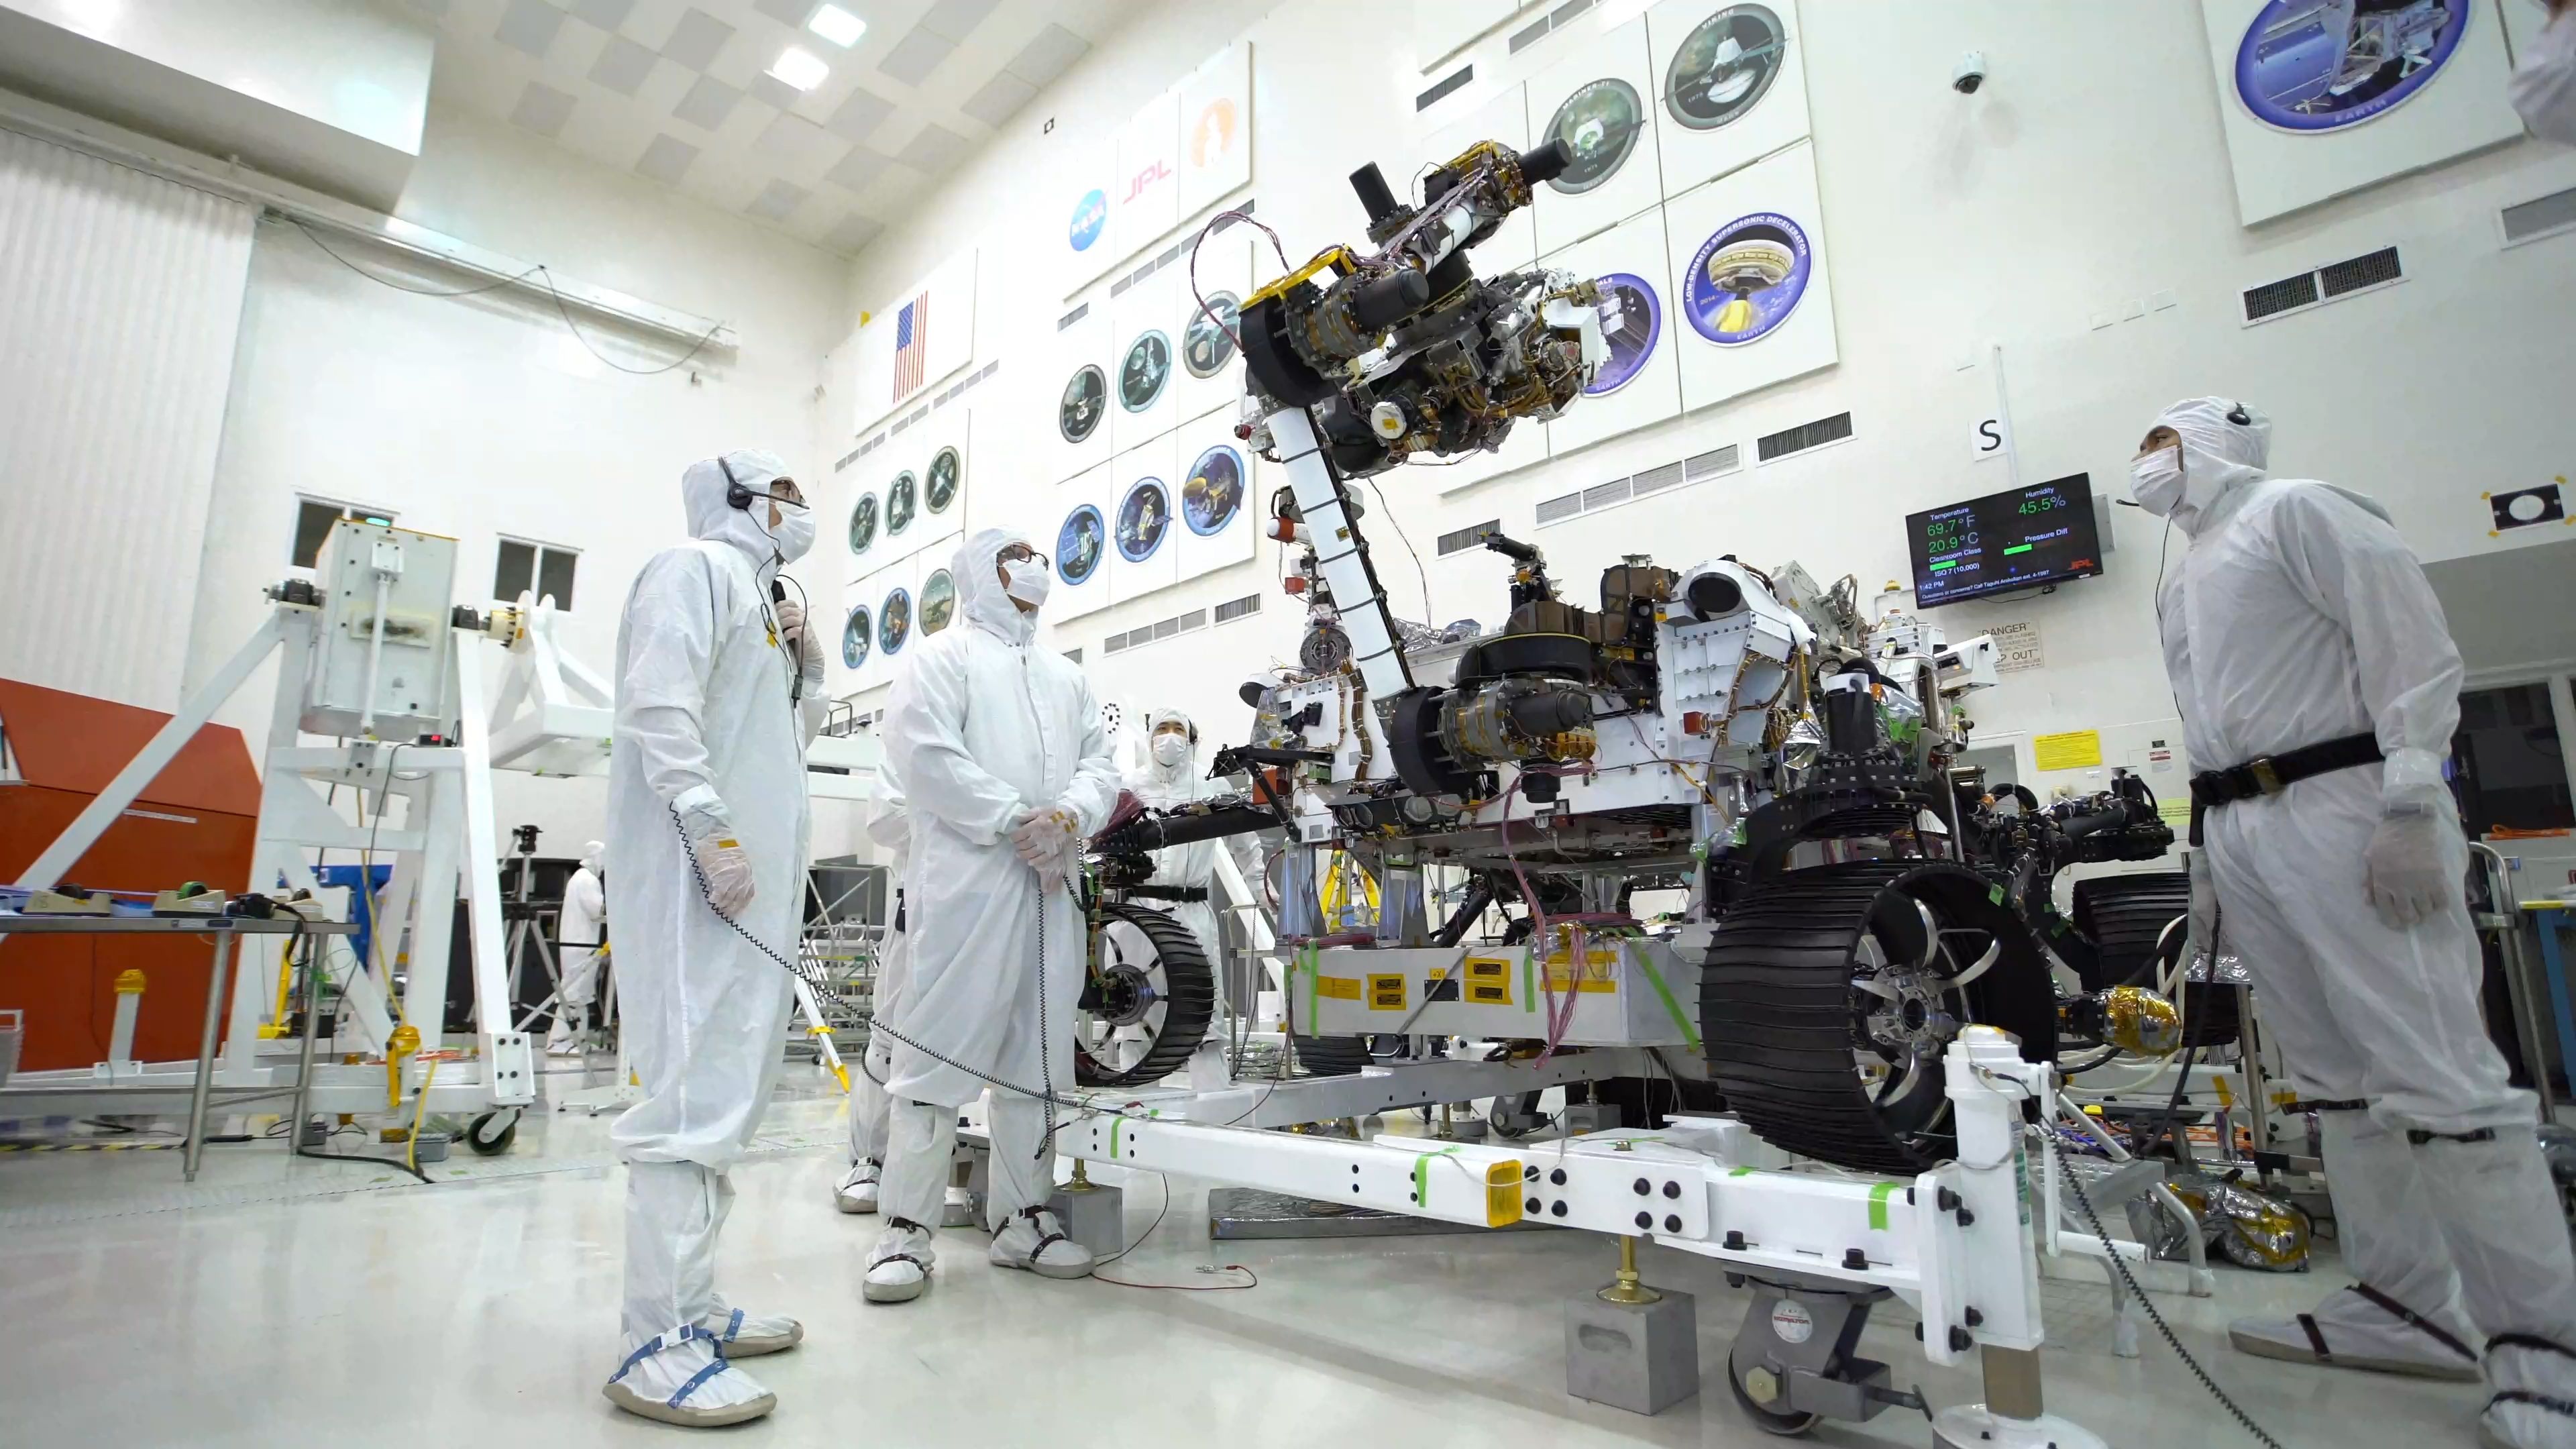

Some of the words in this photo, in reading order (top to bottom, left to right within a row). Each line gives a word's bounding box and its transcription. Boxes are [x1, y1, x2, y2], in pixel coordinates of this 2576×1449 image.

[1701, 9, 1734, 28] VIKING
[2335, 99, 2386, 123] EARTH
[1123, 160, 1171, 205] JPL
[1686, 244, 1711, 302] LOW-DENSITY
[1711, 215, 1765, 244] SUPERSONIC
[1766, 215, 1807, 257] DECELERATOR
[1737, 325, 1766, 340] EARTH
[1596, 378, 1621, 391] EARTH
[1979, 419, 2002, 451] S
[2025, 487, 2054, 498] Humidity
[2019, 494, 2066, 515] 45.5%
[1930, 507, 1970, 521] Temperature
[2025, 531, 2055, 543] Pressure
[2056, 527, 2069, 535] Diff
[1929, 551, 1963, 563] Cleanroom
[1964, 547, 1982, 556] Class
[1933, 580, 1944, 588] PM
